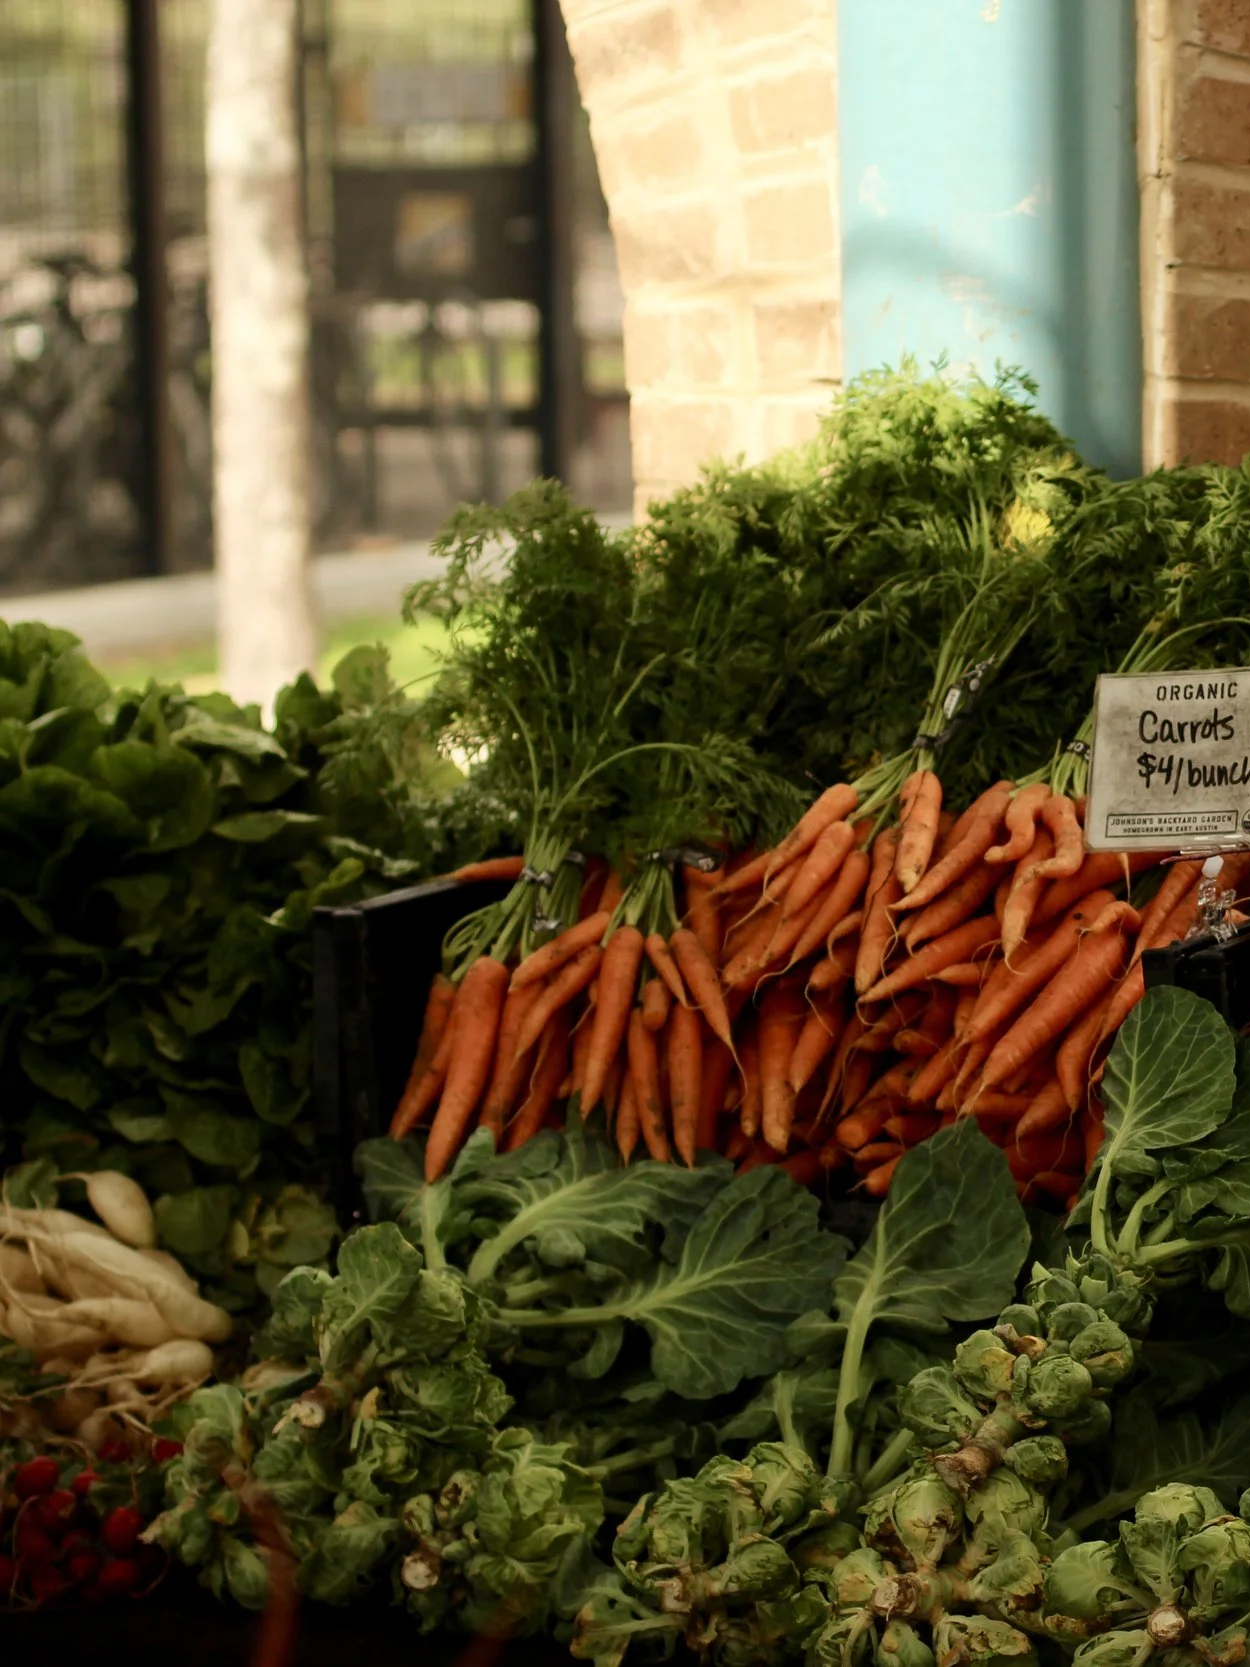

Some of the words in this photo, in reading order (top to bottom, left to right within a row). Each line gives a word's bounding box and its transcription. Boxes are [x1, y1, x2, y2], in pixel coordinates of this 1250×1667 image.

[1156, 682, 1238, 701] ORGANIC
[1138, 708, 1235, 744] Carrots
[1111, 817, 1154, 826] JOHNSON'S
[1158, 816, 1197, 825] BACKYARD
[1201, 815, 1233, 823] GARDEN
